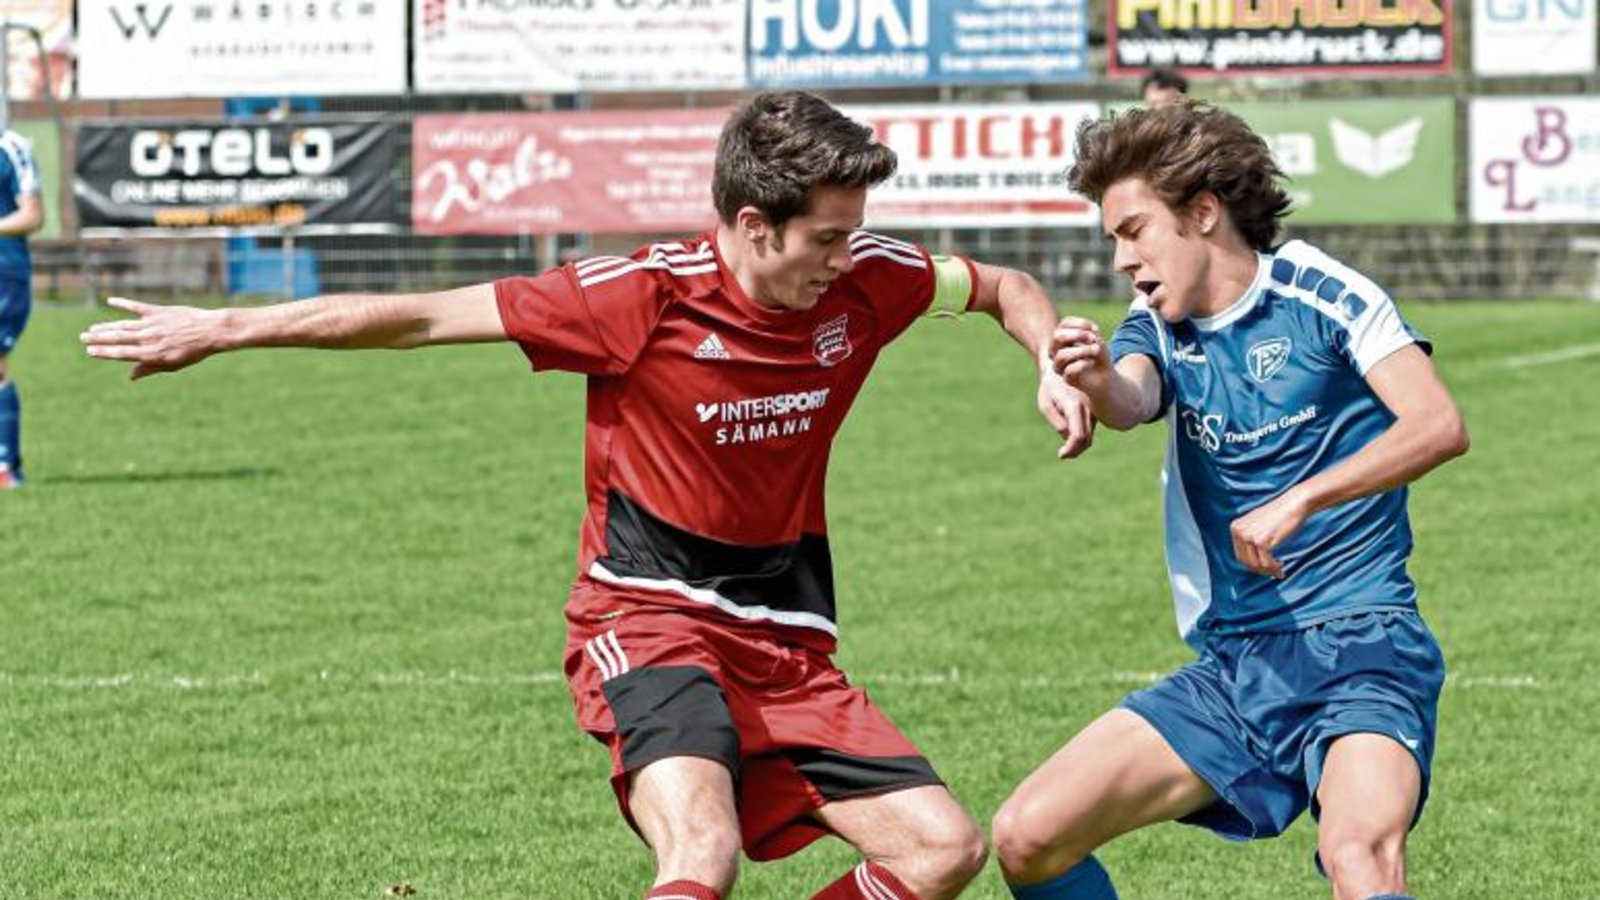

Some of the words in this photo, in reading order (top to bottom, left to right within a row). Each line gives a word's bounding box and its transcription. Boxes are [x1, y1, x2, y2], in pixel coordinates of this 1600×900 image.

[1117, 30, 1445, 69] www.pinidruck.de
[721, 388, 830, 422] INTERSPORT
[1279, 405, 1317, 429] GmbH
[715, 416, 812, 445] SÄMANN
